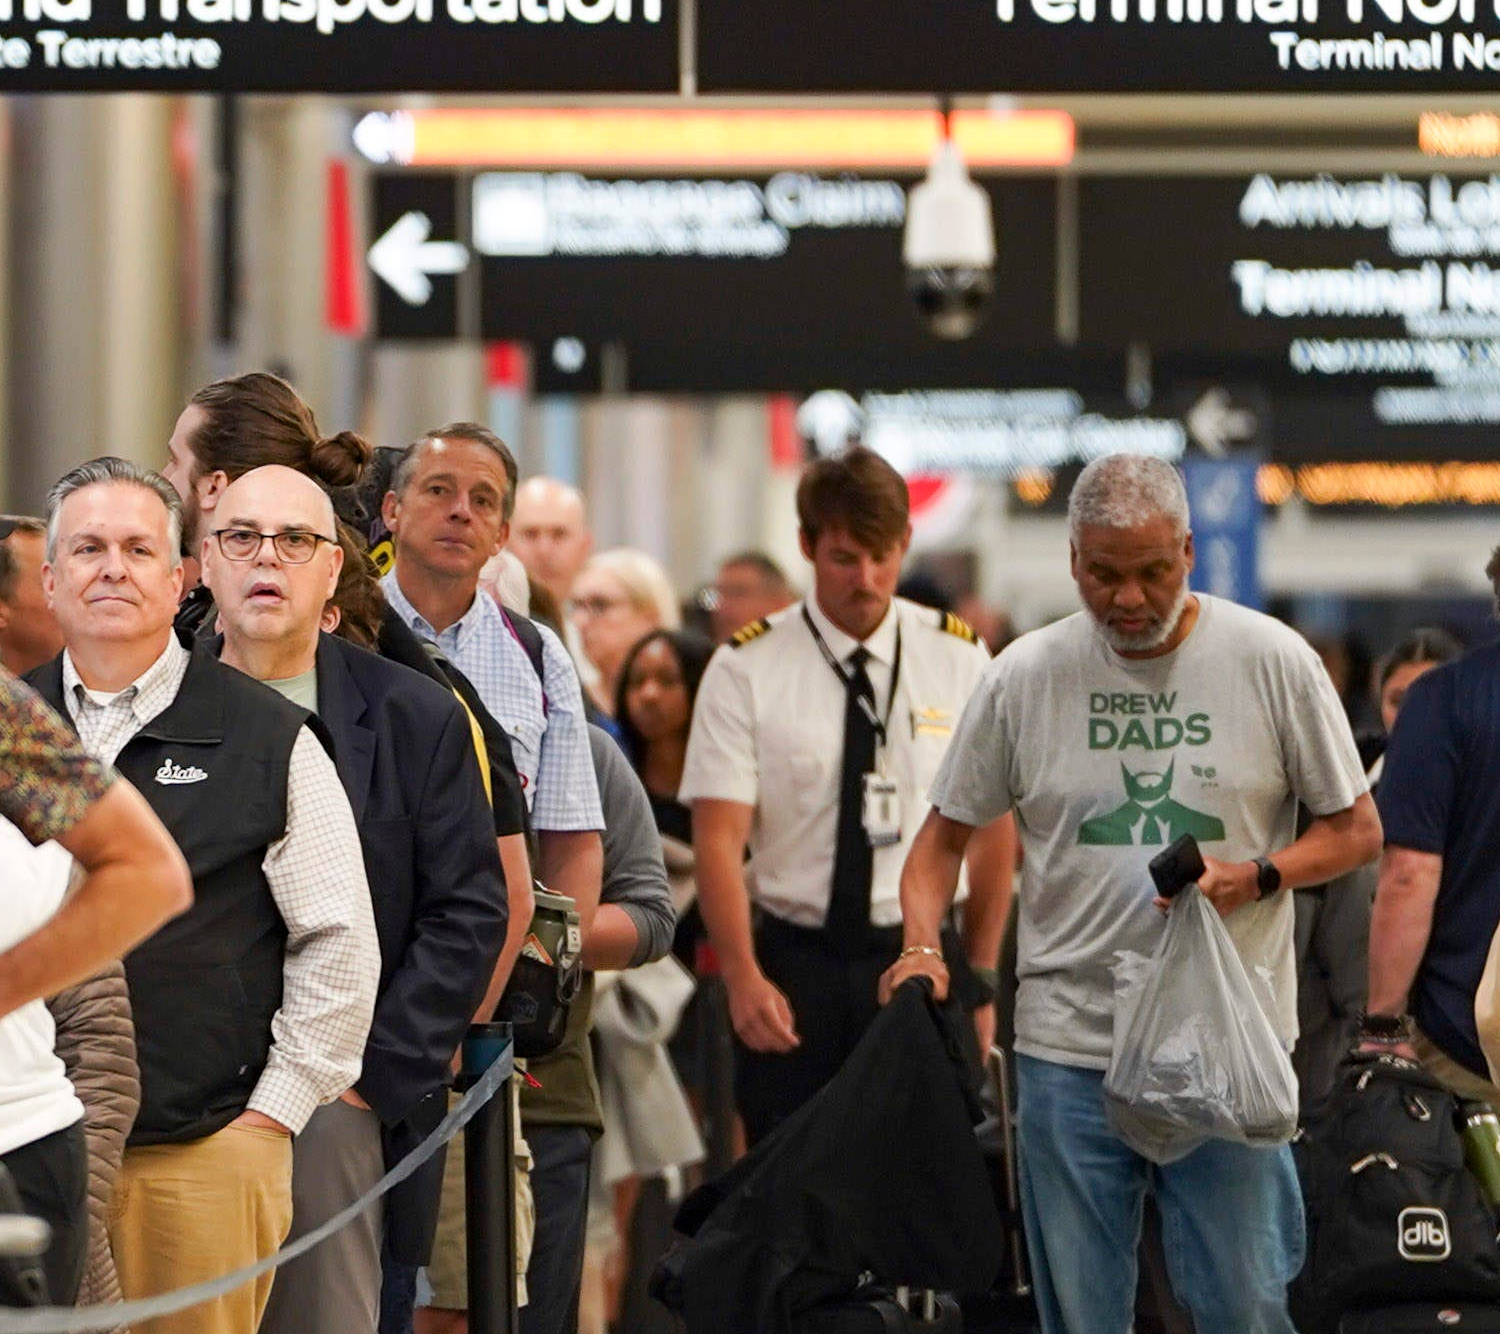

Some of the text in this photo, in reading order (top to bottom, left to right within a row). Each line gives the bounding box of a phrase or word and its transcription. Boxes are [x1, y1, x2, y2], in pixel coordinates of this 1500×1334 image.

[38, 30, 222, 69] Terrestre
[1269, 31, 1443, 71] Terminal
[1090, 691, 1177, 714] DREW
[1088, 712, 1212, 751] DADS
[154, 758, 209, 783] State
